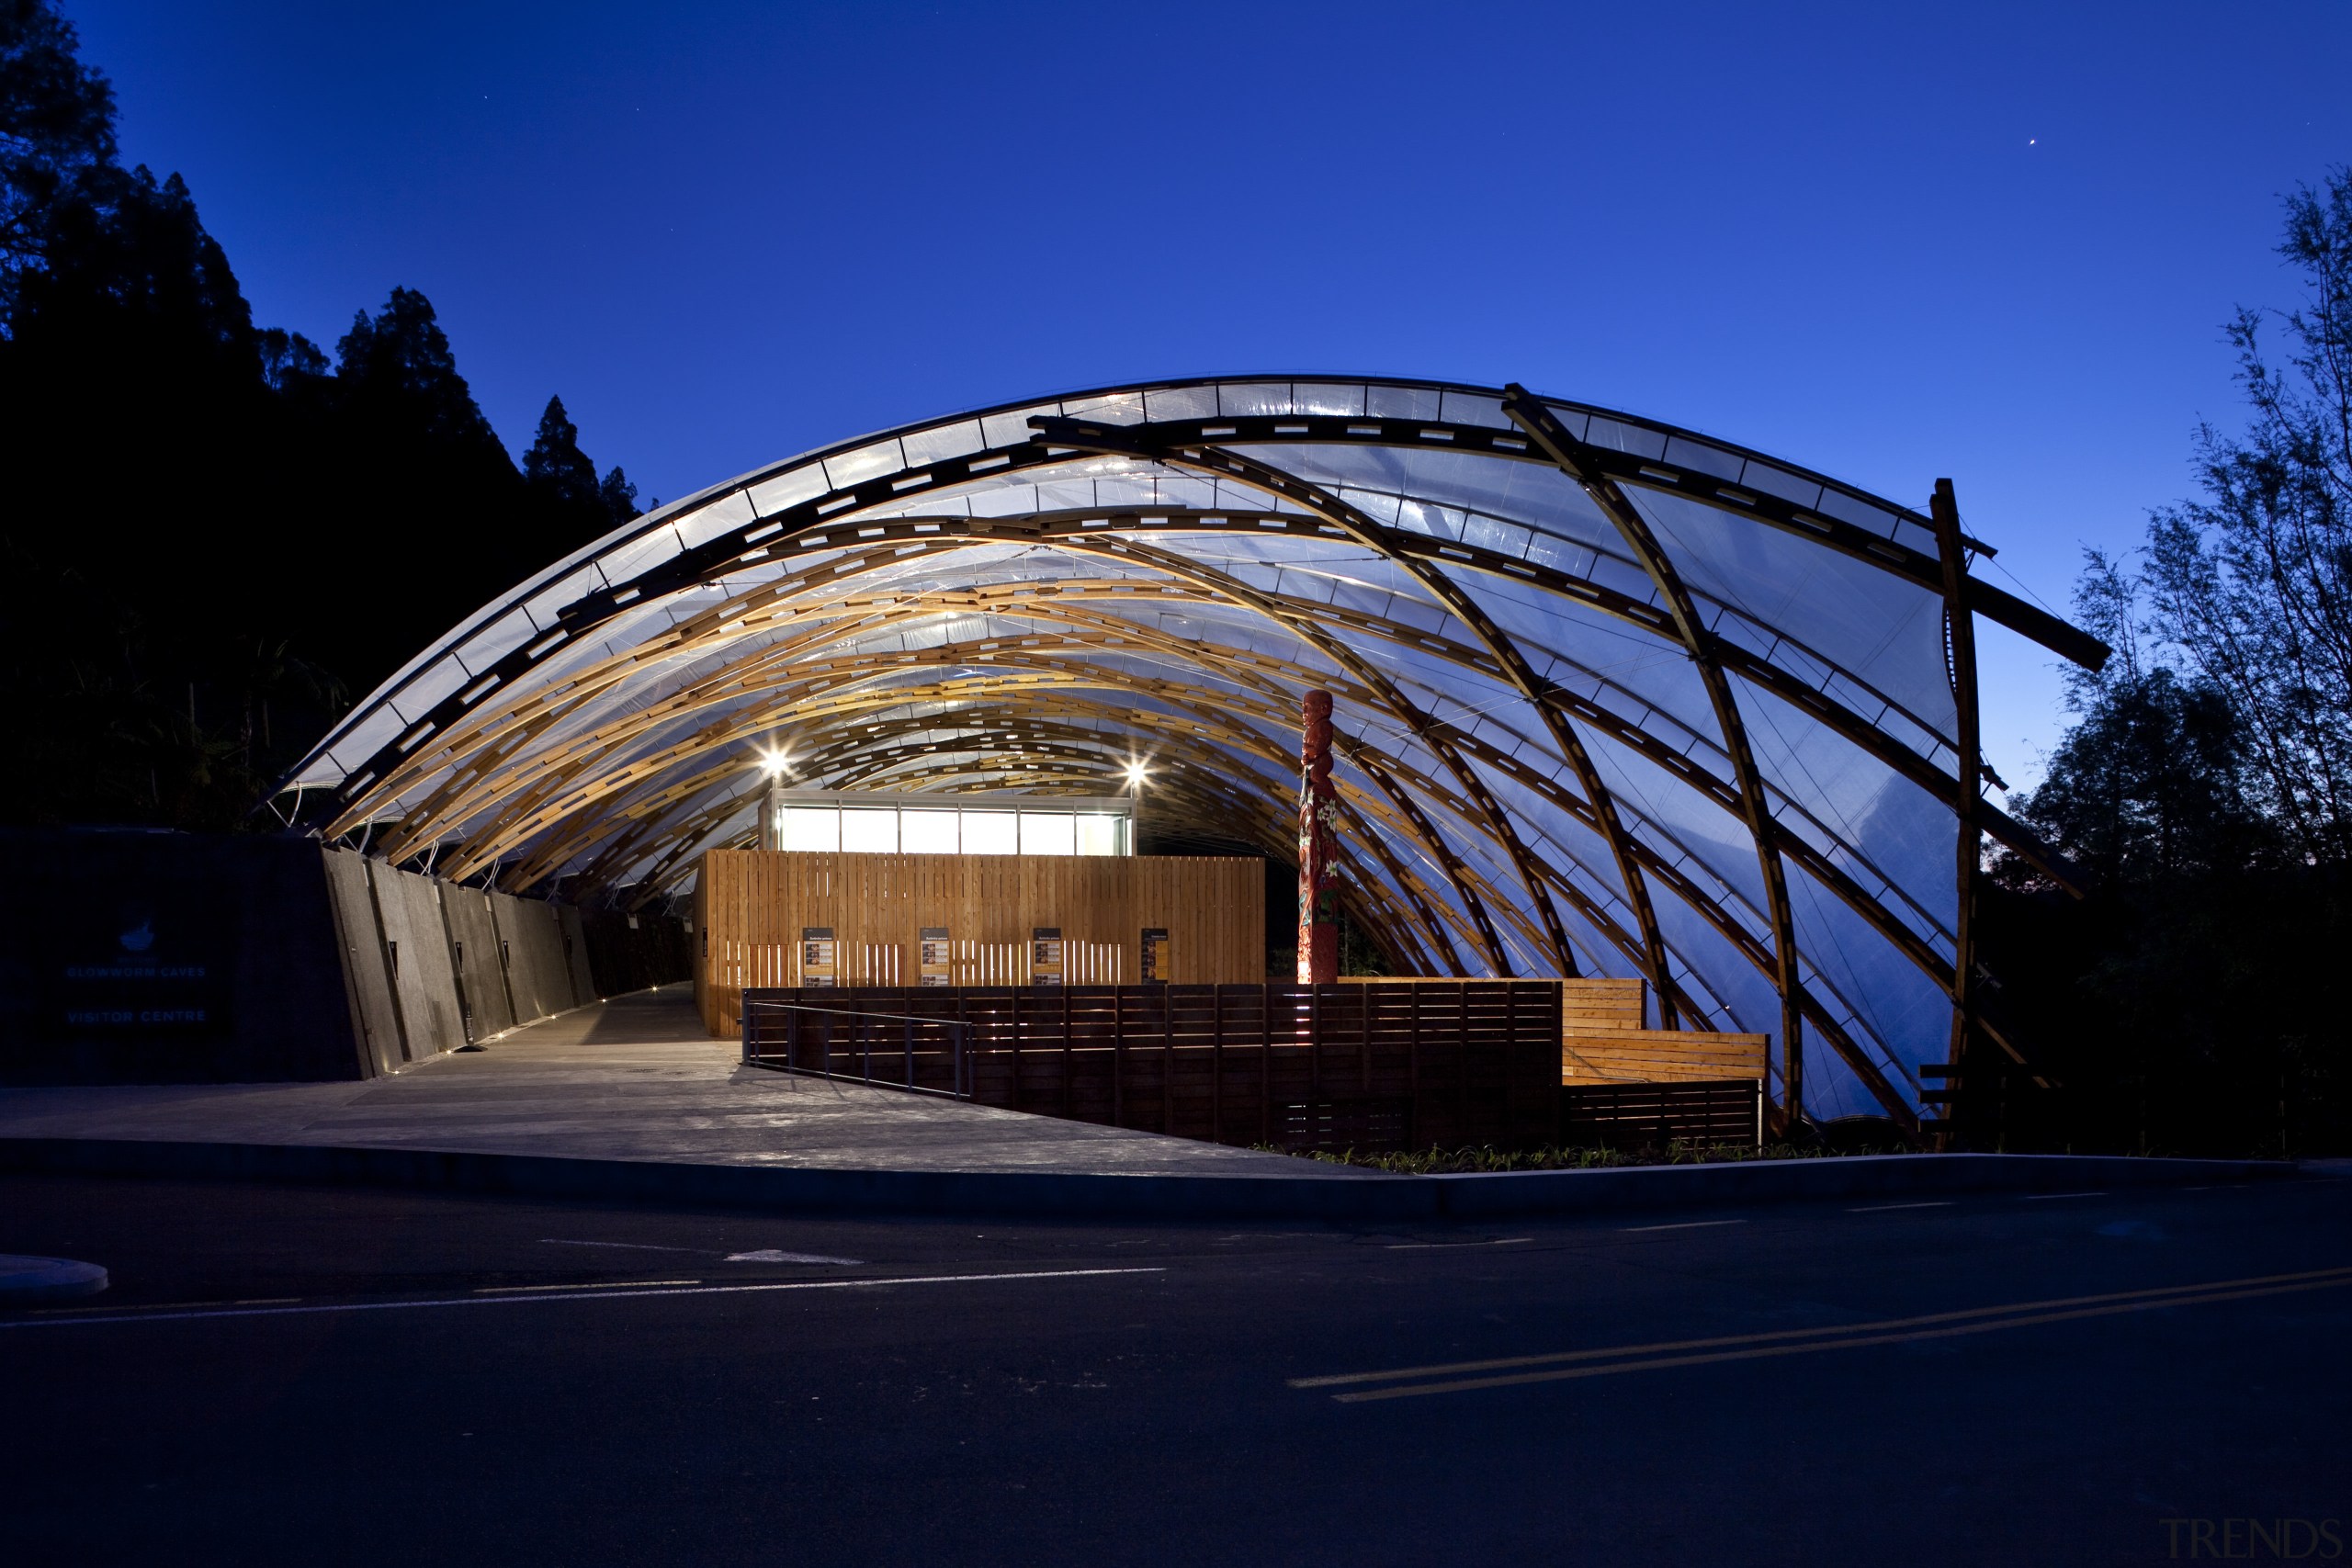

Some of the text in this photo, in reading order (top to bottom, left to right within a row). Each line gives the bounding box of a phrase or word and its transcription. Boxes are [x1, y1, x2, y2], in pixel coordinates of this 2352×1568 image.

[67, 967, 206, 977] GLOWWORM CAVES
[67, 1010, 207, 1023] VISITOR CENTRE
